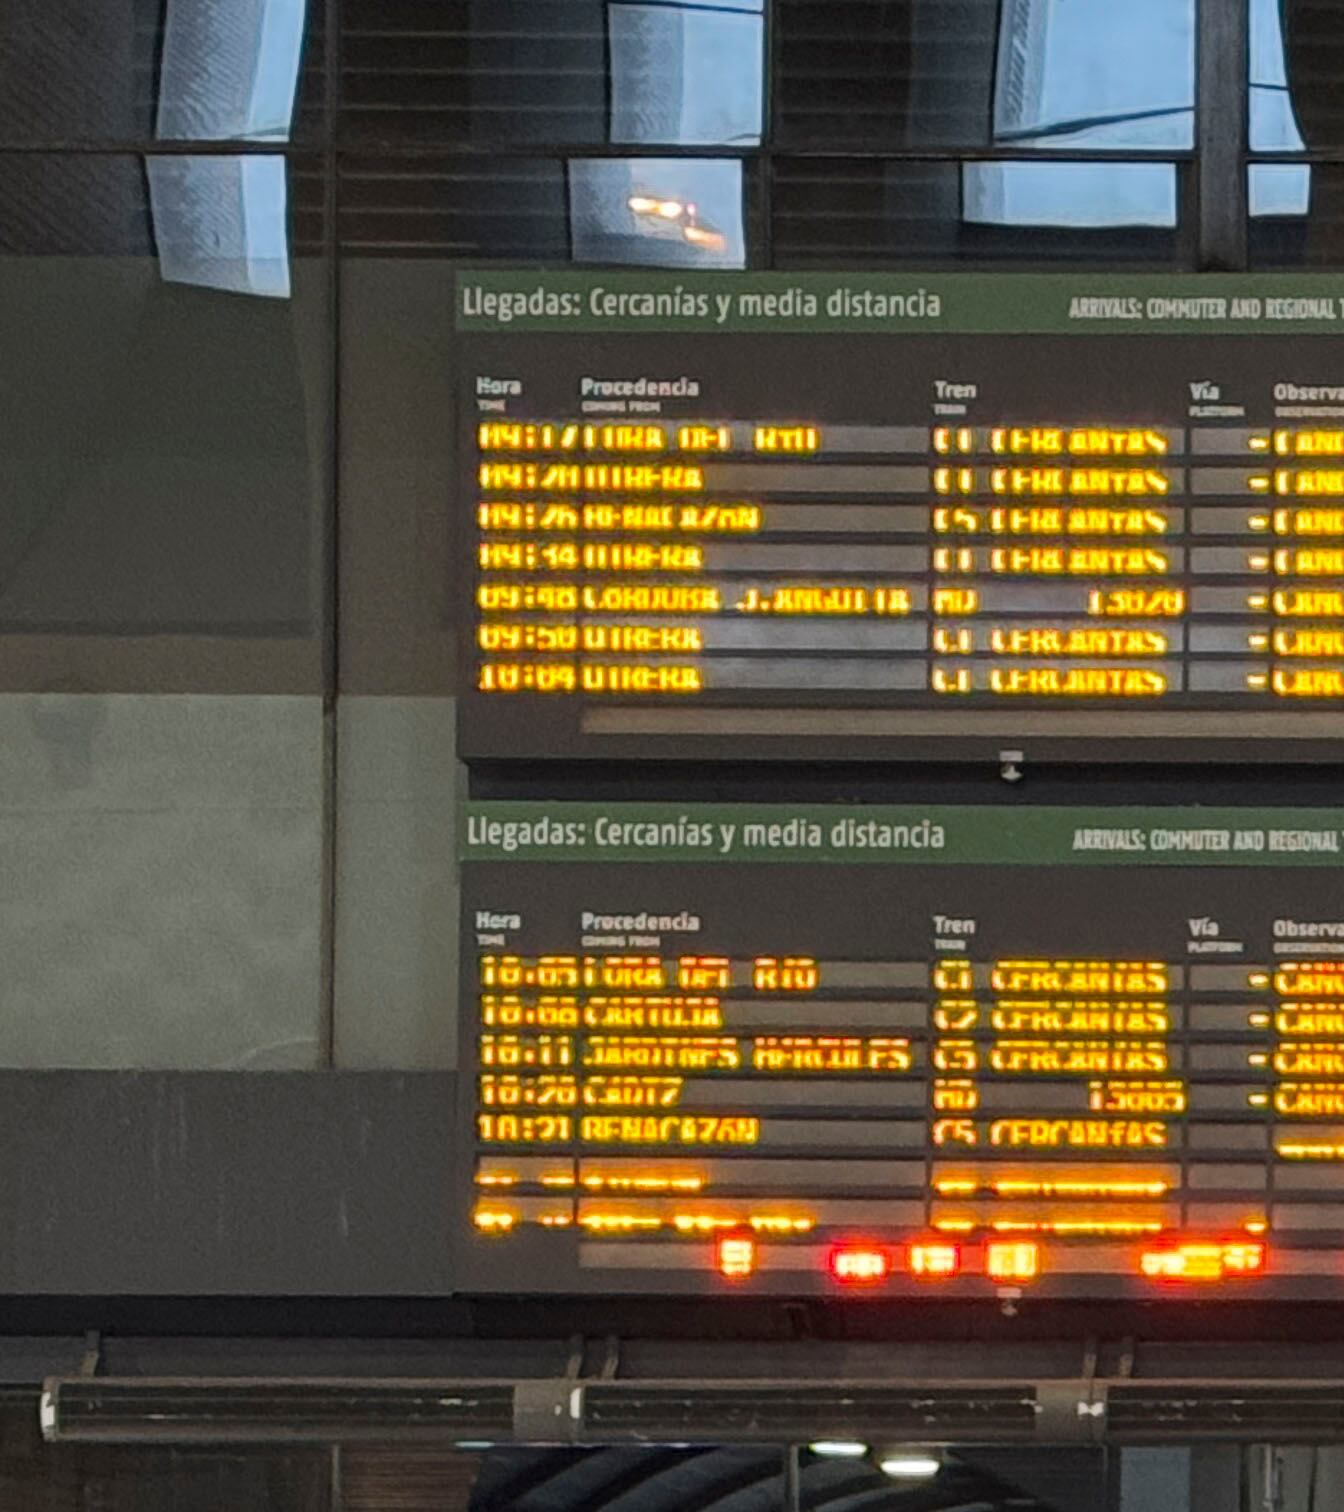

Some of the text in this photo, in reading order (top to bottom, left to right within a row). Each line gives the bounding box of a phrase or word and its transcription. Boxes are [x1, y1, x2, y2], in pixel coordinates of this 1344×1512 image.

[464, 286, 940, 323] Llegadas: Cercanías y media distancia
[1069, 298, 1142, 318] ARRIVALS:
[1147, 298, 1226, 319] COMMUTER
[1230, 298, 1261, 319] AND
[1266, 298, 1336, 319] REGIONAL
[477, 378, 699, 397] Hora Procedencia
[935, 381, 976, 398] Tren
[1190, 381, 1219, 400] Vía
[468, 816, 944, 852] Llegadas: Cercanías y media distancia
[1073, 829, 1146, 850] ARRIVALS:
[1150, 830, 1230, 850] COMMUTER
[1233, 831, 1264, 851] AND
[1269, 830, 1339, 852] REGIONAL
[582, 912, 699, 931] Procedencia
[933, 916, 975, 934] Tren
[1189, 917, 1218, 936] Vía
